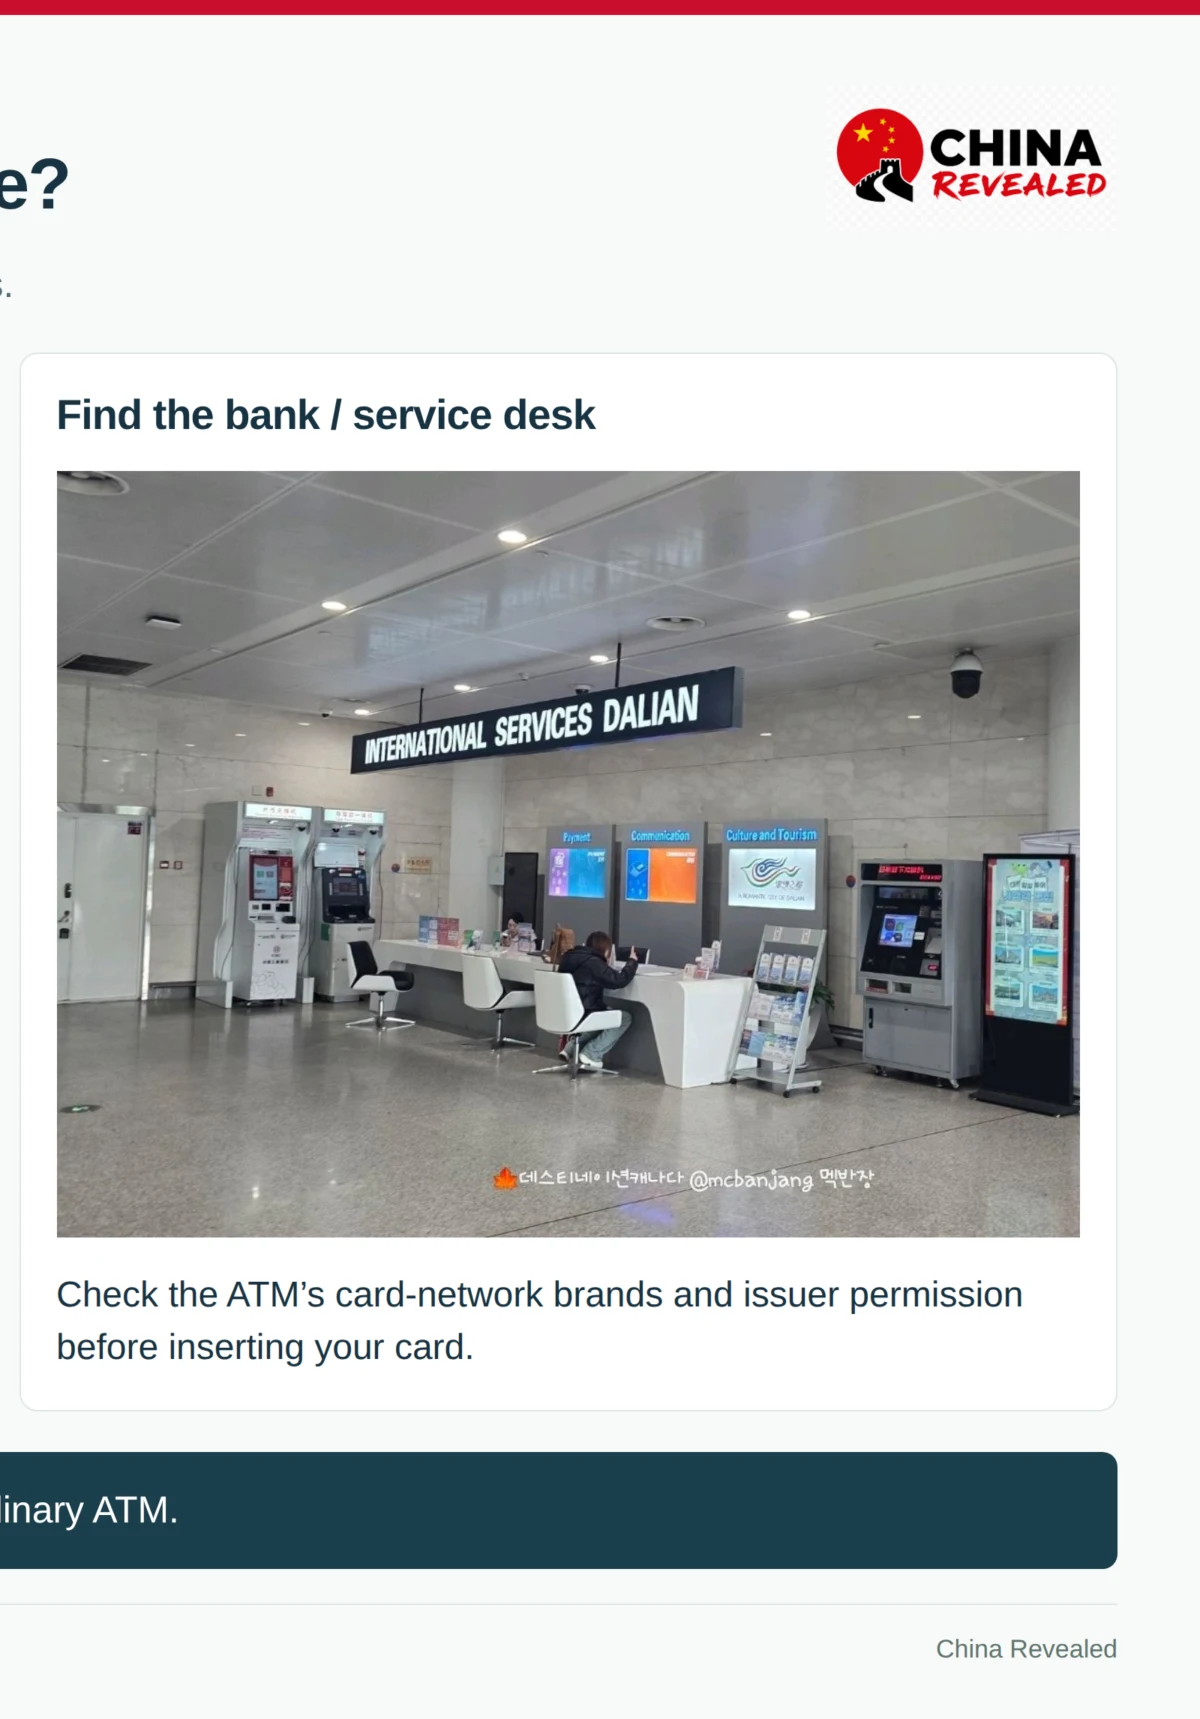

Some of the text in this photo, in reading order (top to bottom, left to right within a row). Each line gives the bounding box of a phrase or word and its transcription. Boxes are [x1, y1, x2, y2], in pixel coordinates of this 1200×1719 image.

[364, 684, 700, 765] INTERNATIONAL SERVICES DALIAN
[562, 831, 592, 844] Payment
[630, 829, 691, 842] Communication
[726, 828, 817, 842] Culture and Tourism
